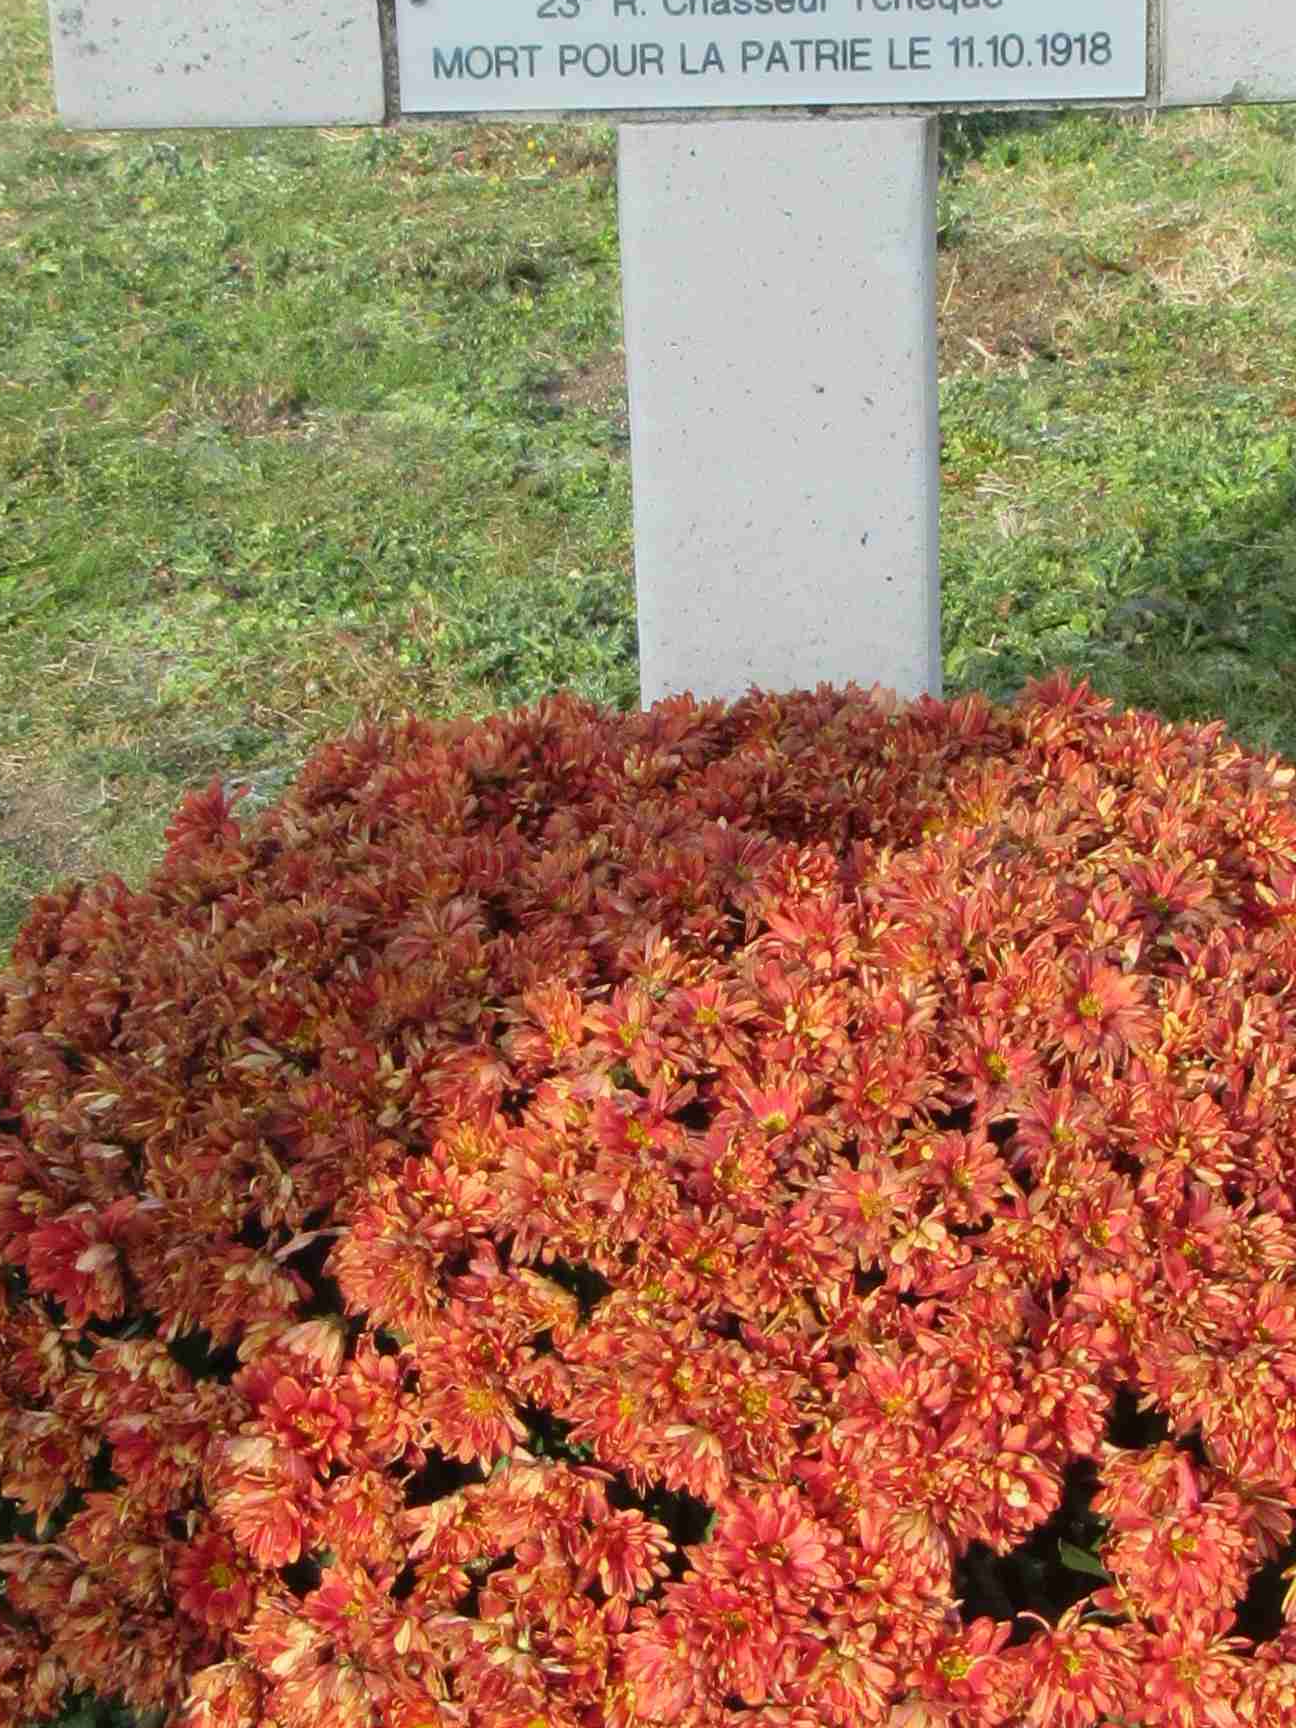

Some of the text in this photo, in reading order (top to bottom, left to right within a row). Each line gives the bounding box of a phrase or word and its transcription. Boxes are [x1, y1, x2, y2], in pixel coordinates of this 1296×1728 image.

[432, 31, 1112, 79] MORT POUR LA PATRIE LE 11.10.1918
